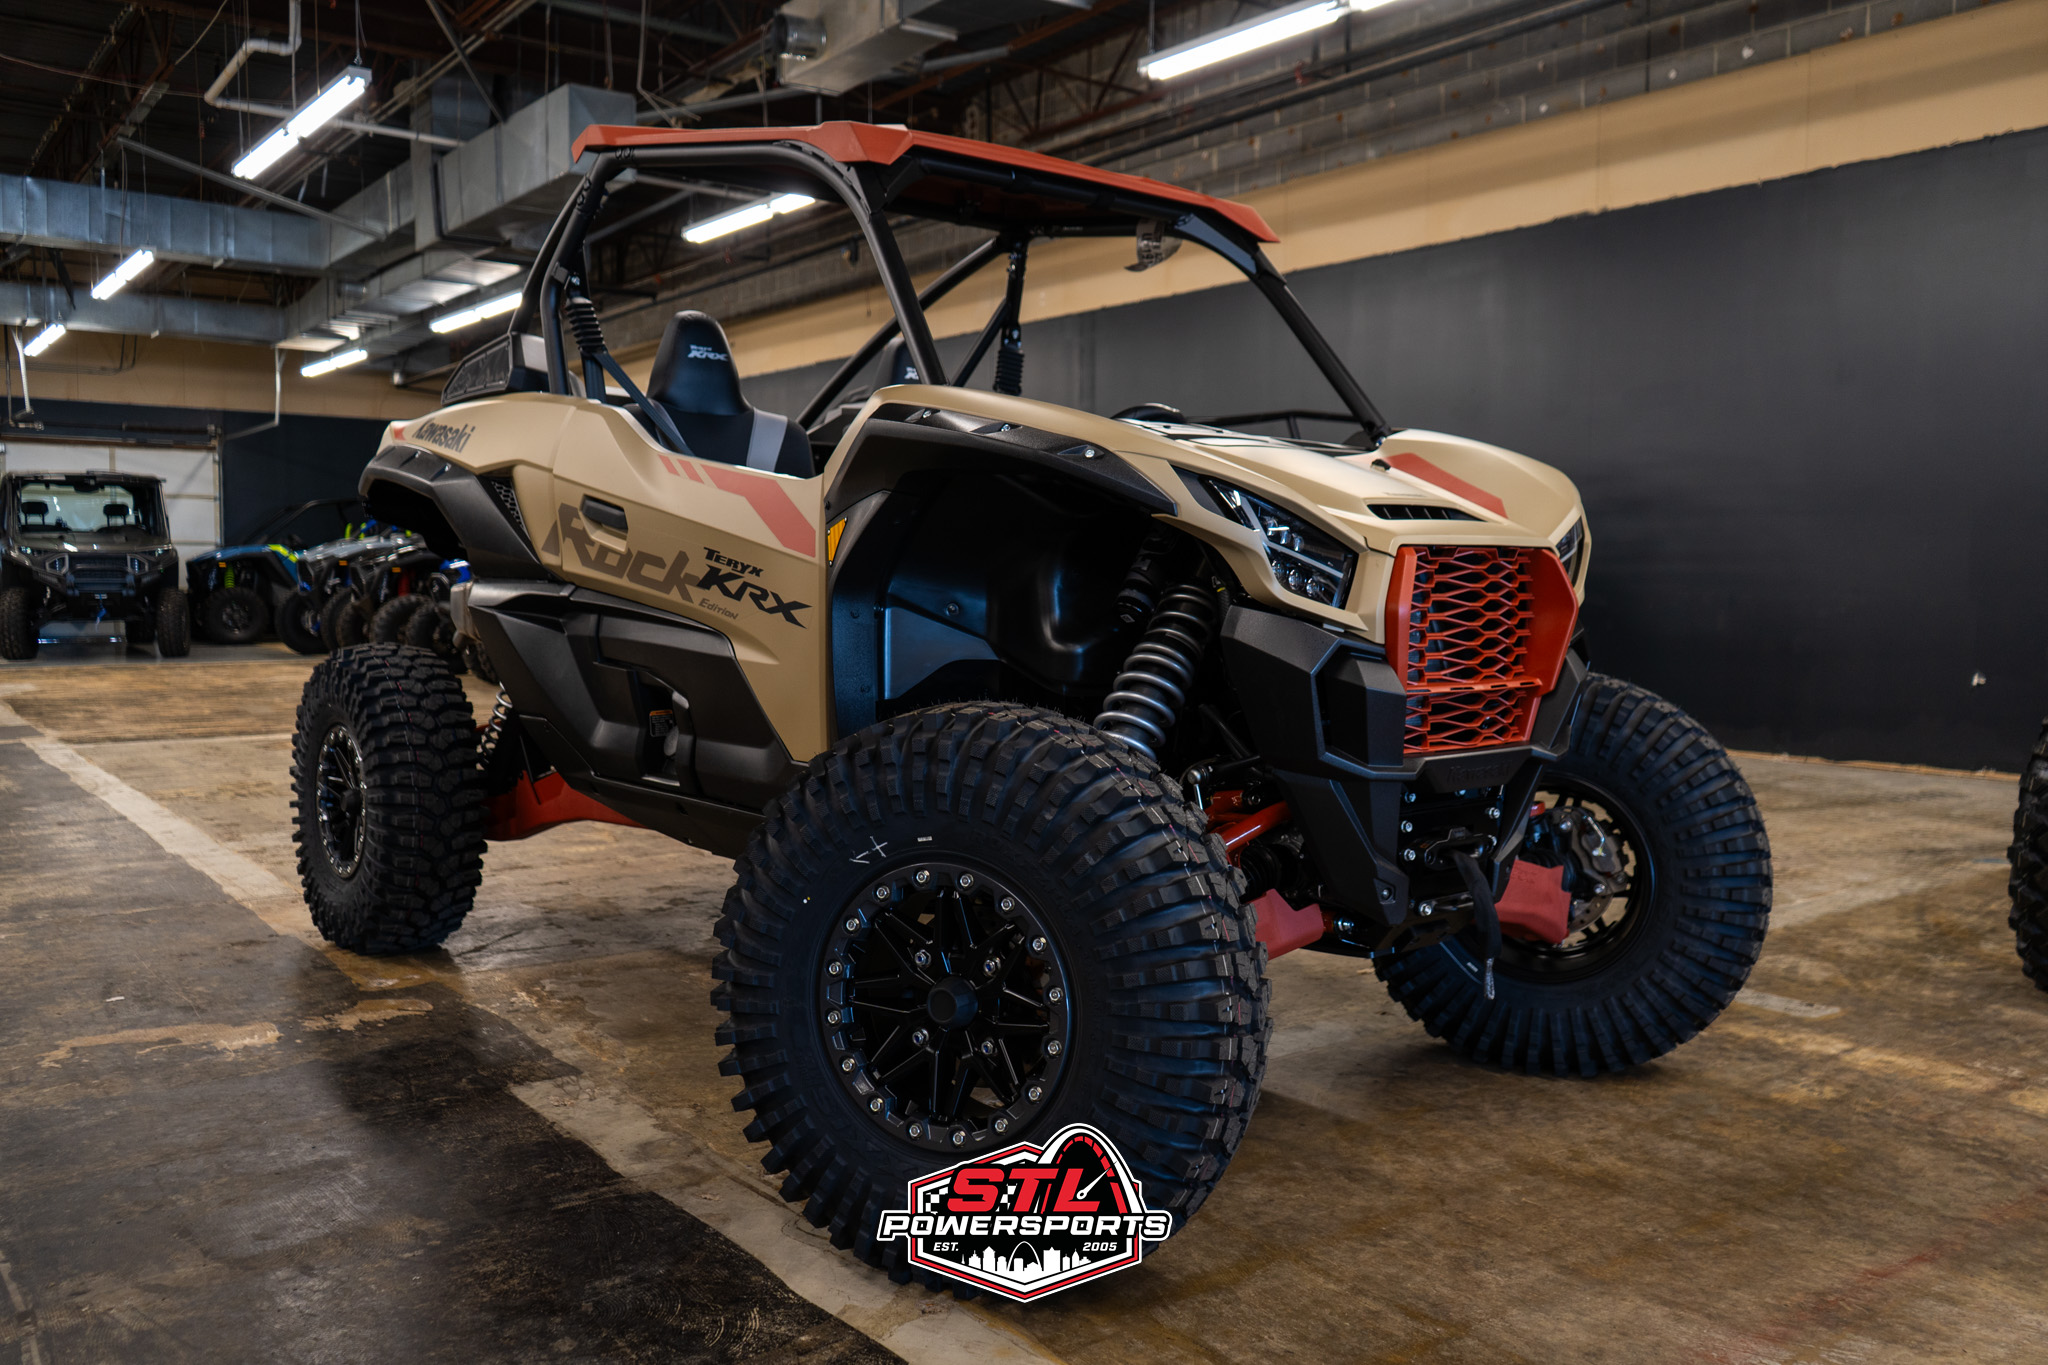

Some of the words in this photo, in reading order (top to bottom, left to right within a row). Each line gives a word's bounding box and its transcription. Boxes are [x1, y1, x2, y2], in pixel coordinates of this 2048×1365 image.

[412, 418, 476, 454] Kawasaki
[542, 503, 702, 604] Rock
[696, 564, 813, 629] KRX
